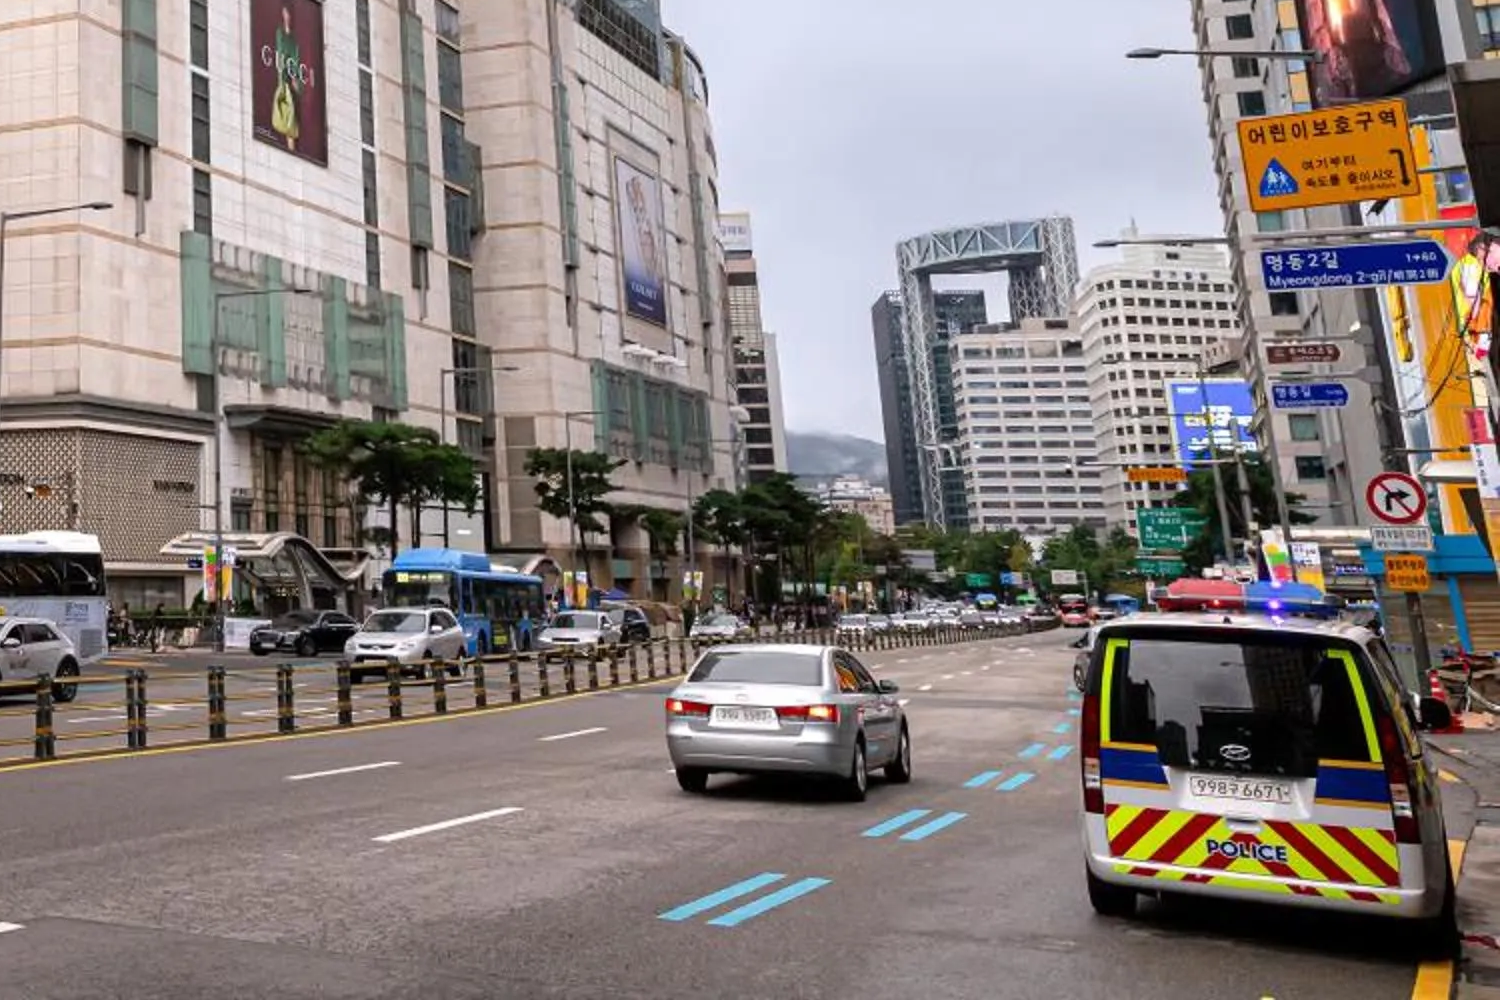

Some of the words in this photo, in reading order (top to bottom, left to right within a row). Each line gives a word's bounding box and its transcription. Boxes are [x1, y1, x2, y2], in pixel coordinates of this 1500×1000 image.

[261, 45, 315, 88] GUCCI
[1248, 108, 1397, 145] 어린이보호구역
[1265, 251, 1339, 272] 명동2길
[1269, 272, 1353, 289] Myeongdong
[1206, 838, 1288, 862] POLICE
